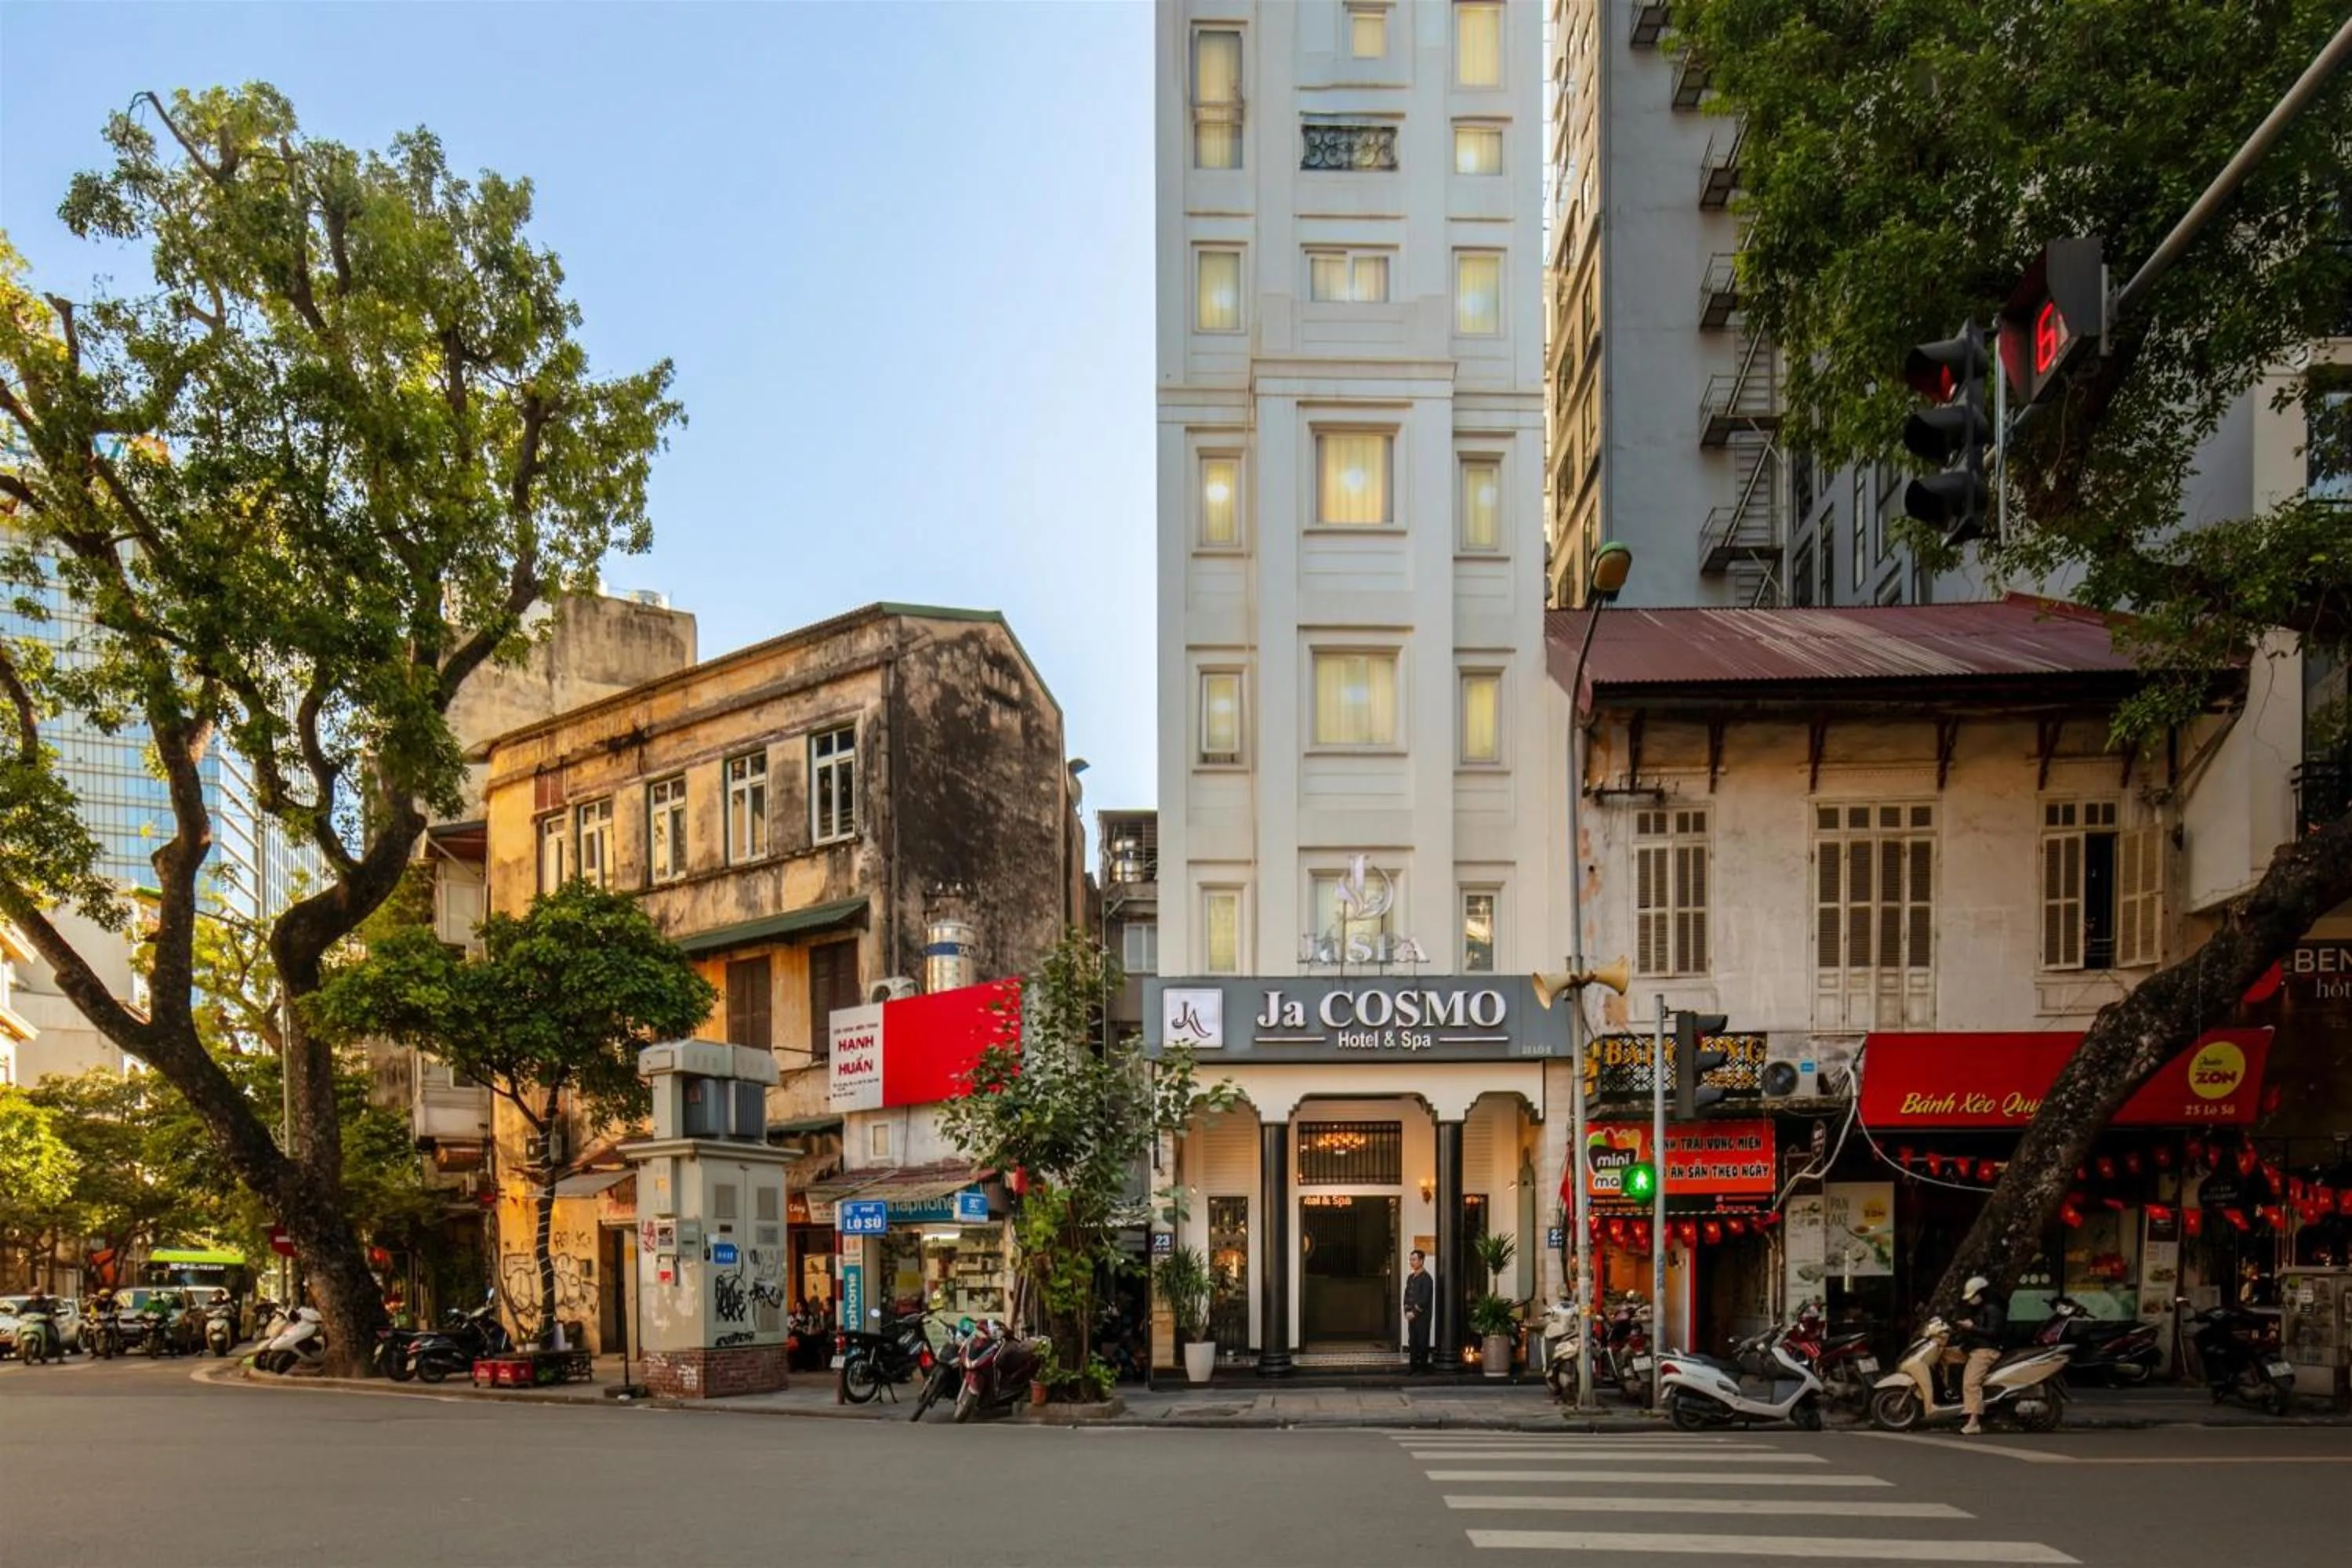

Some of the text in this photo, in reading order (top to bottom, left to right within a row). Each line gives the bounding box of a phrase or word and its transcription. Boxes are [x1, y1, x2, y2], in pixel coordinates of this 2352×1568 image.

[2034, 301, 2056, 375] 6
[1257, 989, 1507, 1028] Ja COSMO
[1338, 1031, 1432, 1051] Hotel & Spa
[2195, 1070, 2238, 1084] ZON
[1900, 1092, 1956, 1114] Bánh
[1958, 1092, 1996, 1114] Xèo
[1596, 1152, 1630, 1167] mini
[1711, 1164, 1738, 1179] THEO
[846, 1214, 862, 1230] LÒ
[1155, 1234, 1171, 1246] 23
